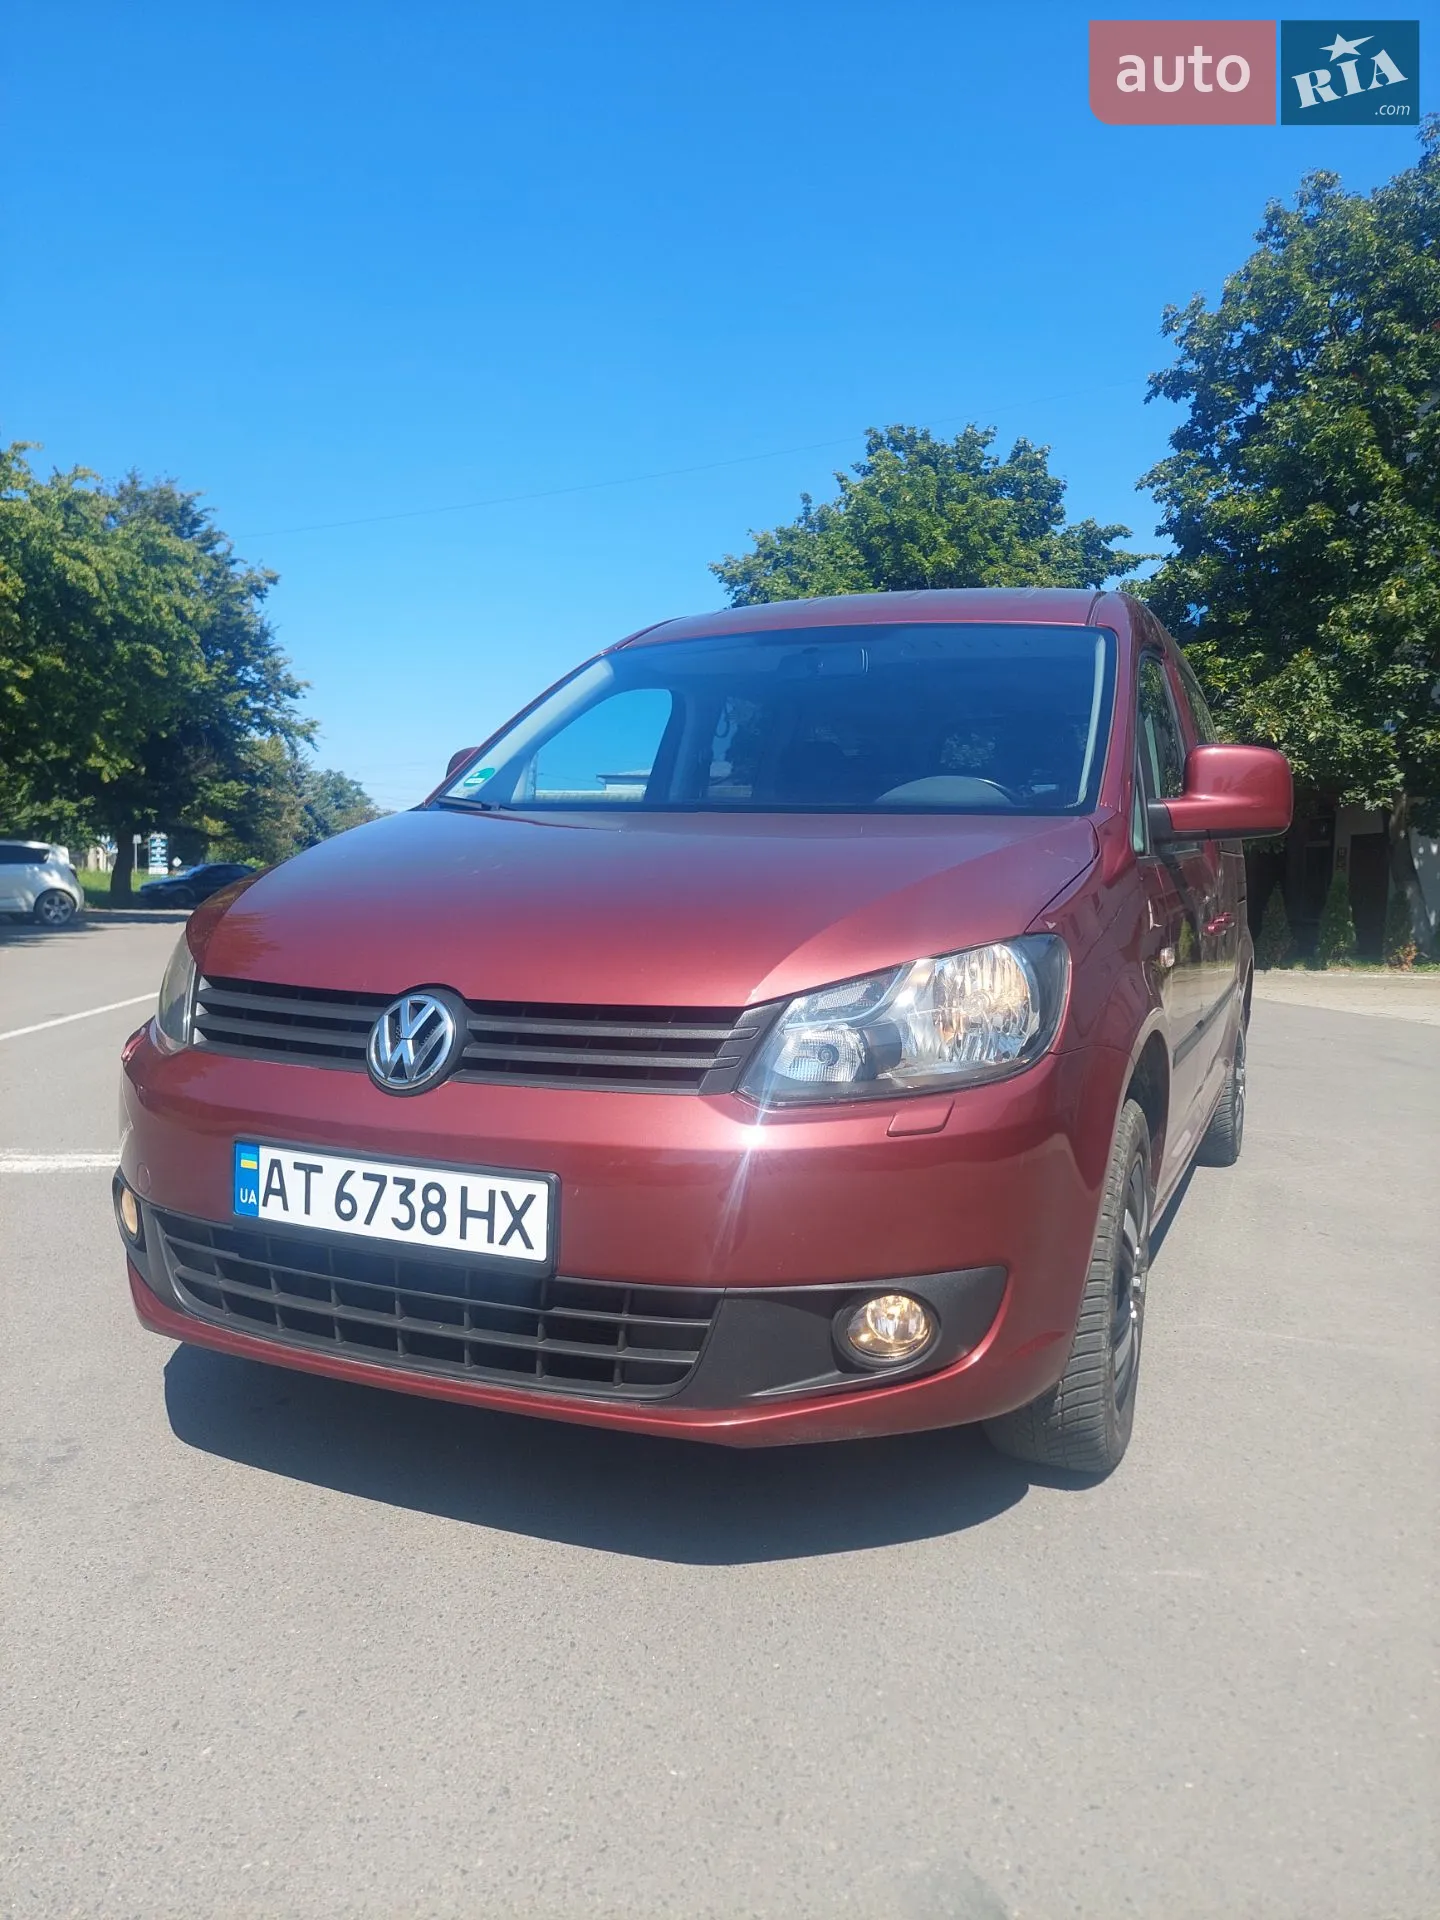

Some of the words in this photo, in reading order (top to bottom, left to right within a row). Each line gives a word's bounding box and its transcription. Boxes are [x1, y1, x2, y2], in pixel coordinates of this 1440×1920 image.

[239, 1187, 257, 1205] UA
[262, 1158, 323, 1216] AT
[334, 1169, 447, 1237] 6738
[459, 1185, 537, 1250] HX
